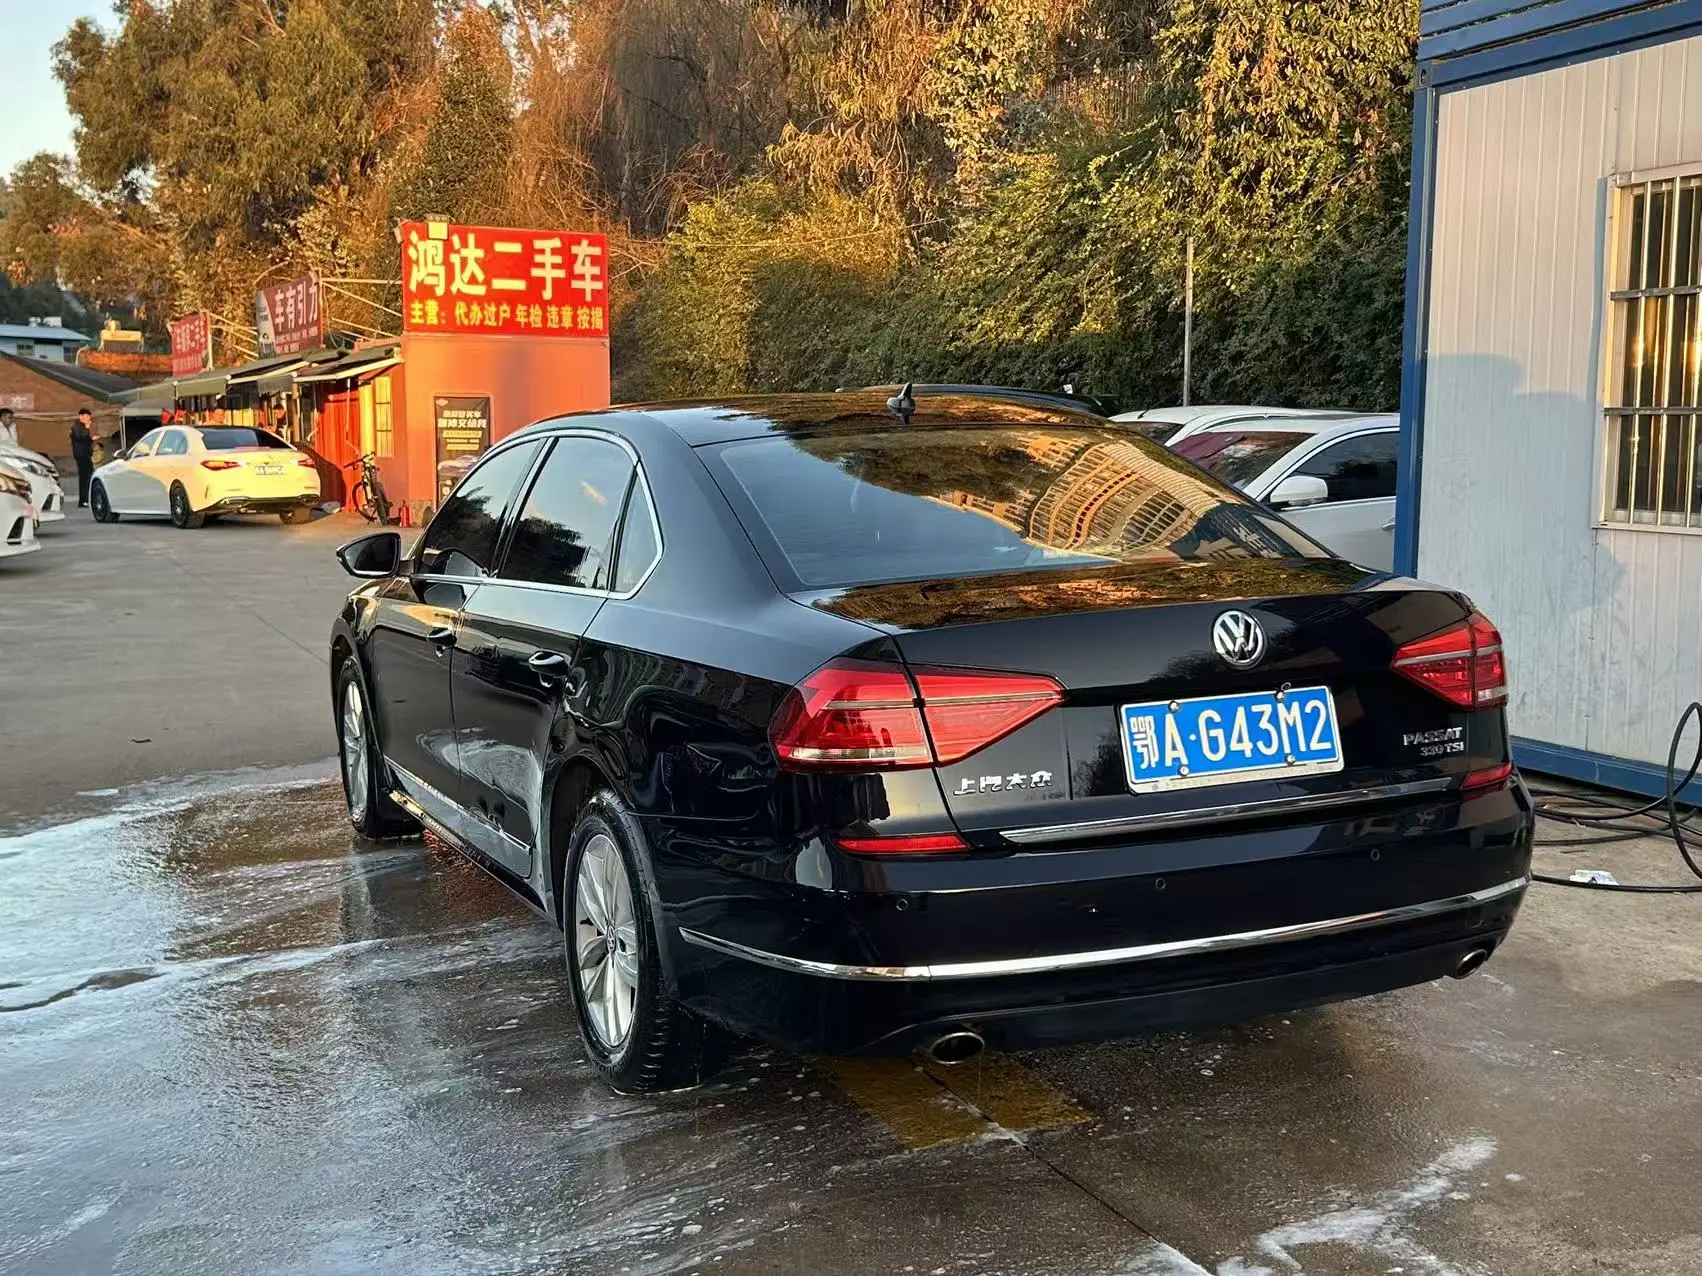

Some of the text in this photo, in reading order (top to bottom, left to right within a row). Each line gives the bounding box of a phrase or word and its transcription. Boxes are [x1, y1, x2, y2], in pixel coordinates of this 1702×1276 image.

[408, 230, 604, 302] 鸿达二手车
[275, 281, 318, 333] 车有引力
[455, 301, 511, 327] 代办过户
[516, 303, 543, 329] 年检
[547, 305, 574, 330] 违章
[577, 306, 604, 331] 按揭
[1129, 699, 1332, 769] 鄂A·G43M2
[1402, 726, 1463, 746] PASSAT
[953, 770, 1053, 796] 上汽大众
